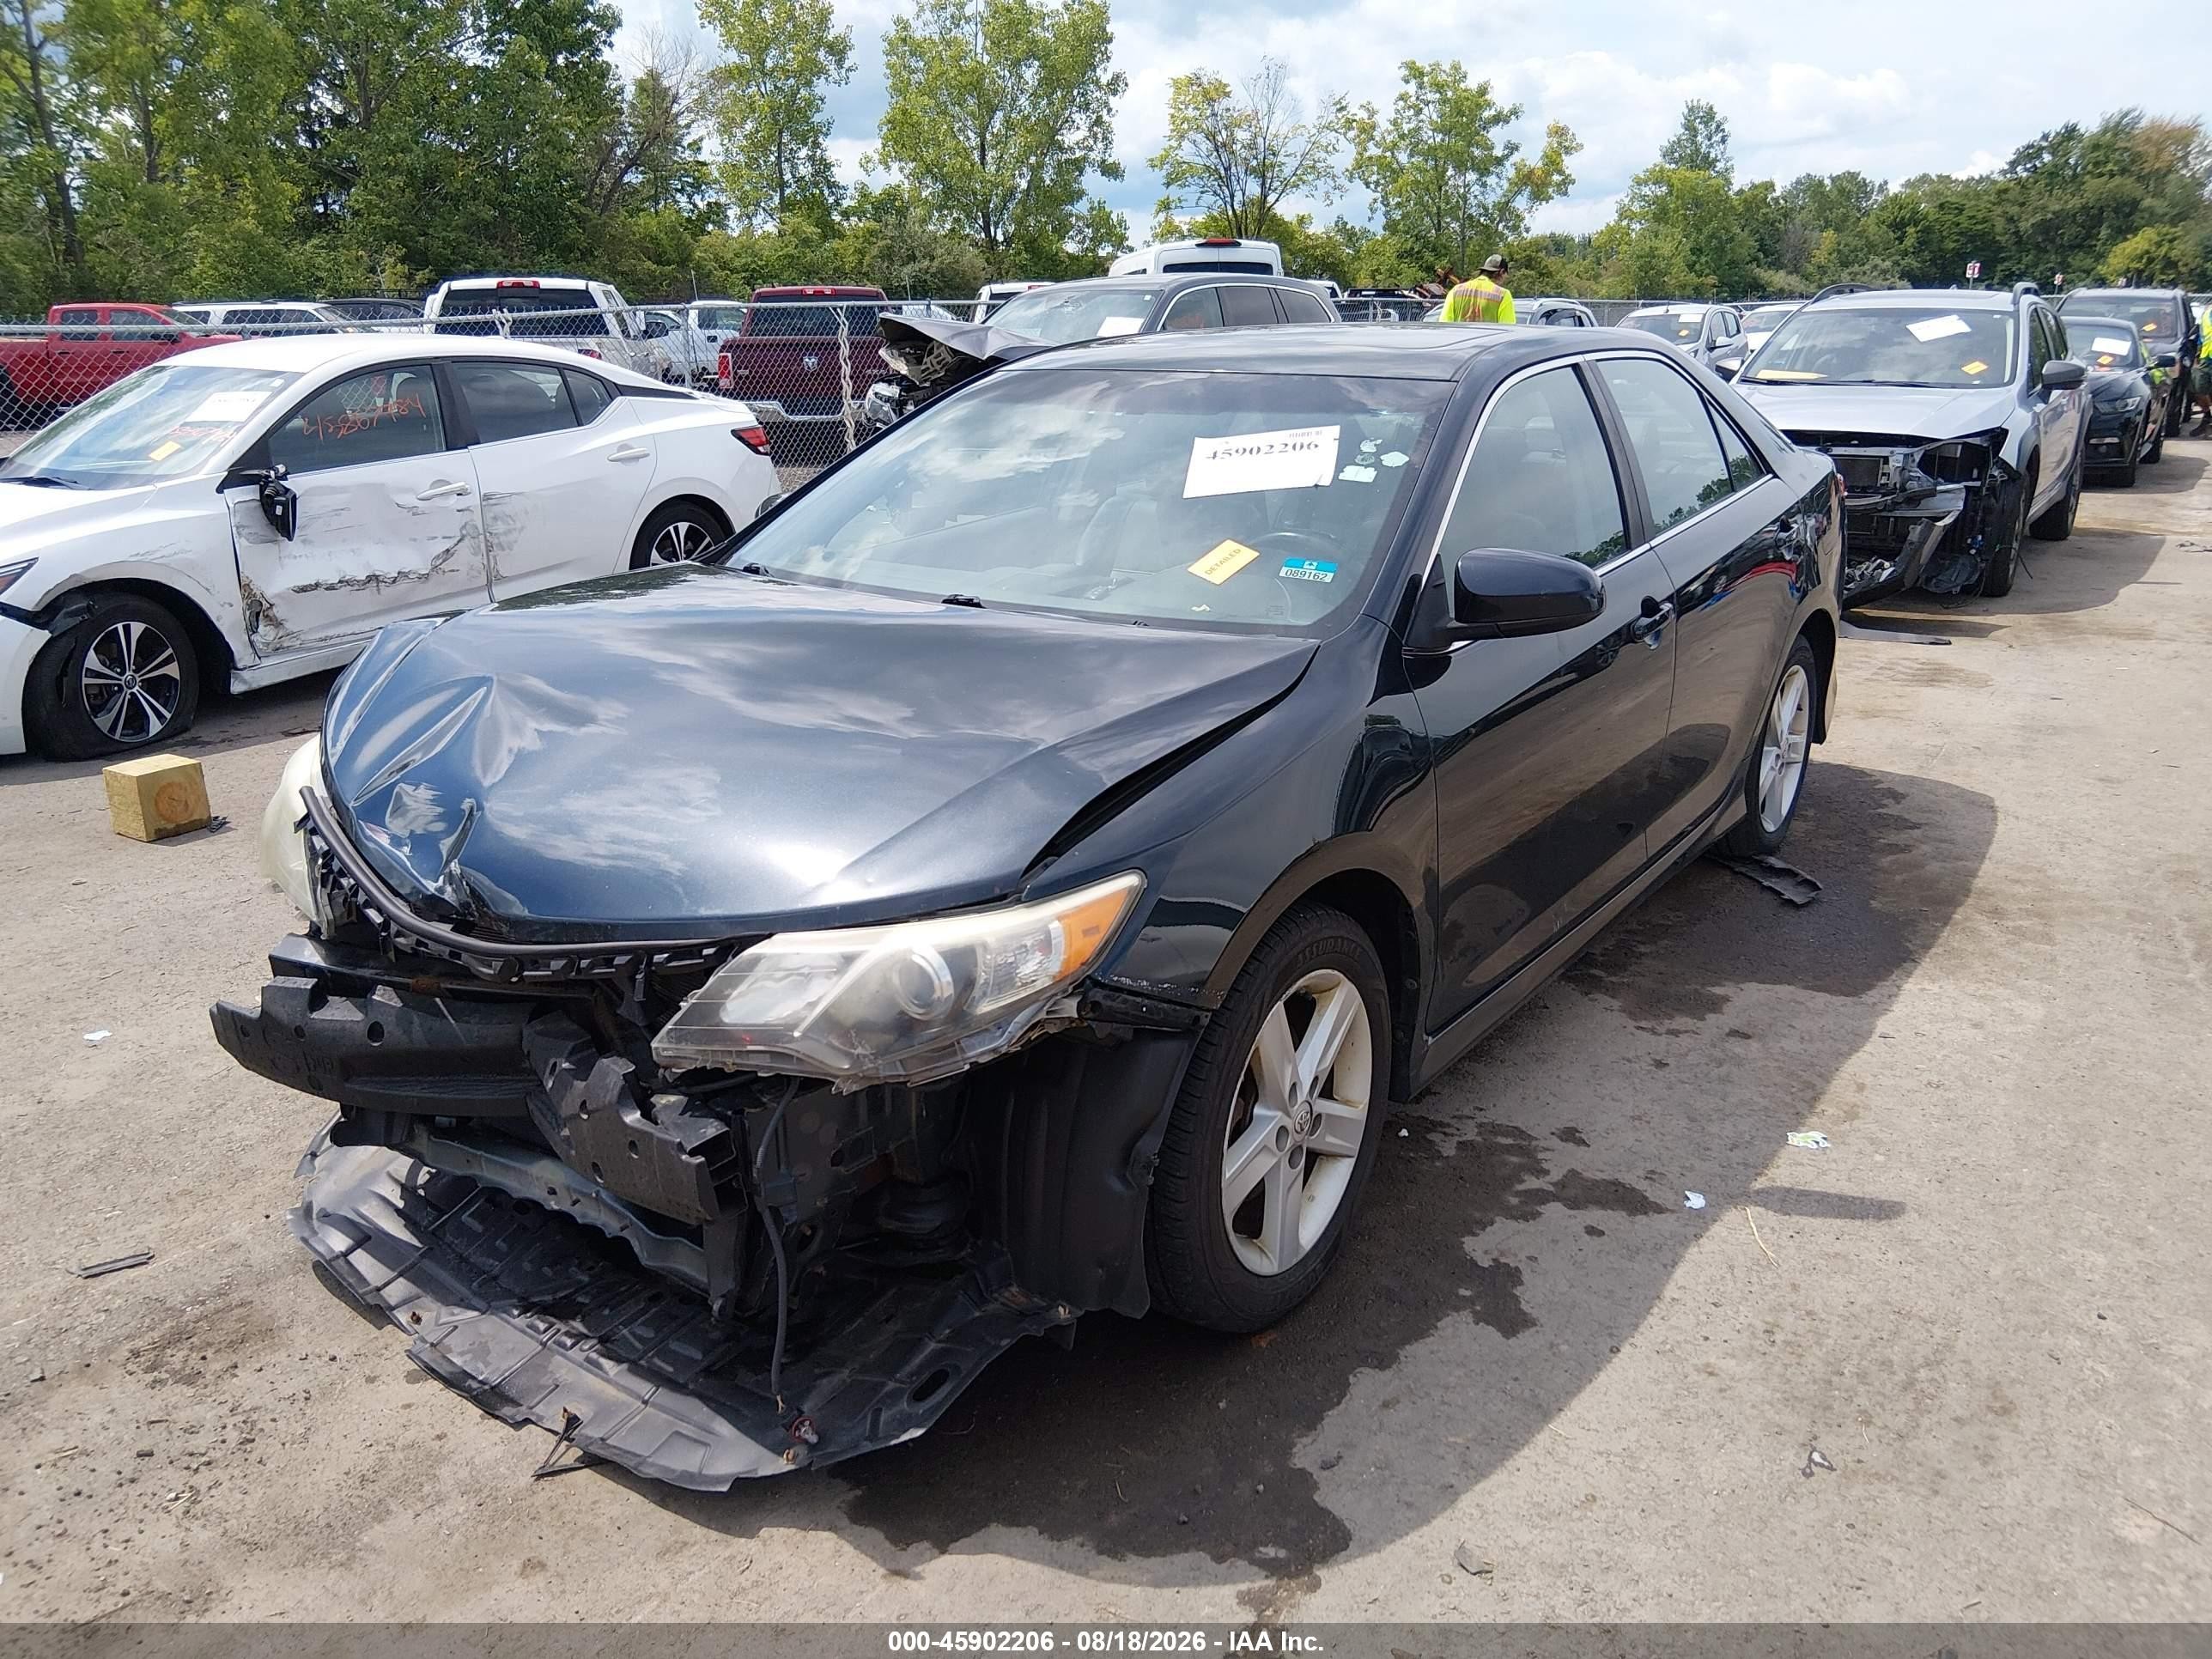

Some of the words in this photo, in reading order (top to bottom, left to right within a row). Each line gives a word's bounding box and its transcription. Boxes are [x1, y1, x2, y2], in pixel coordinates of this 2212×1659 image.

[1206, 441, 1319, 459] 45902206
[1205, 548, 1242, 575] DETAILED
[1285, 568, 1328, 581] 089162
